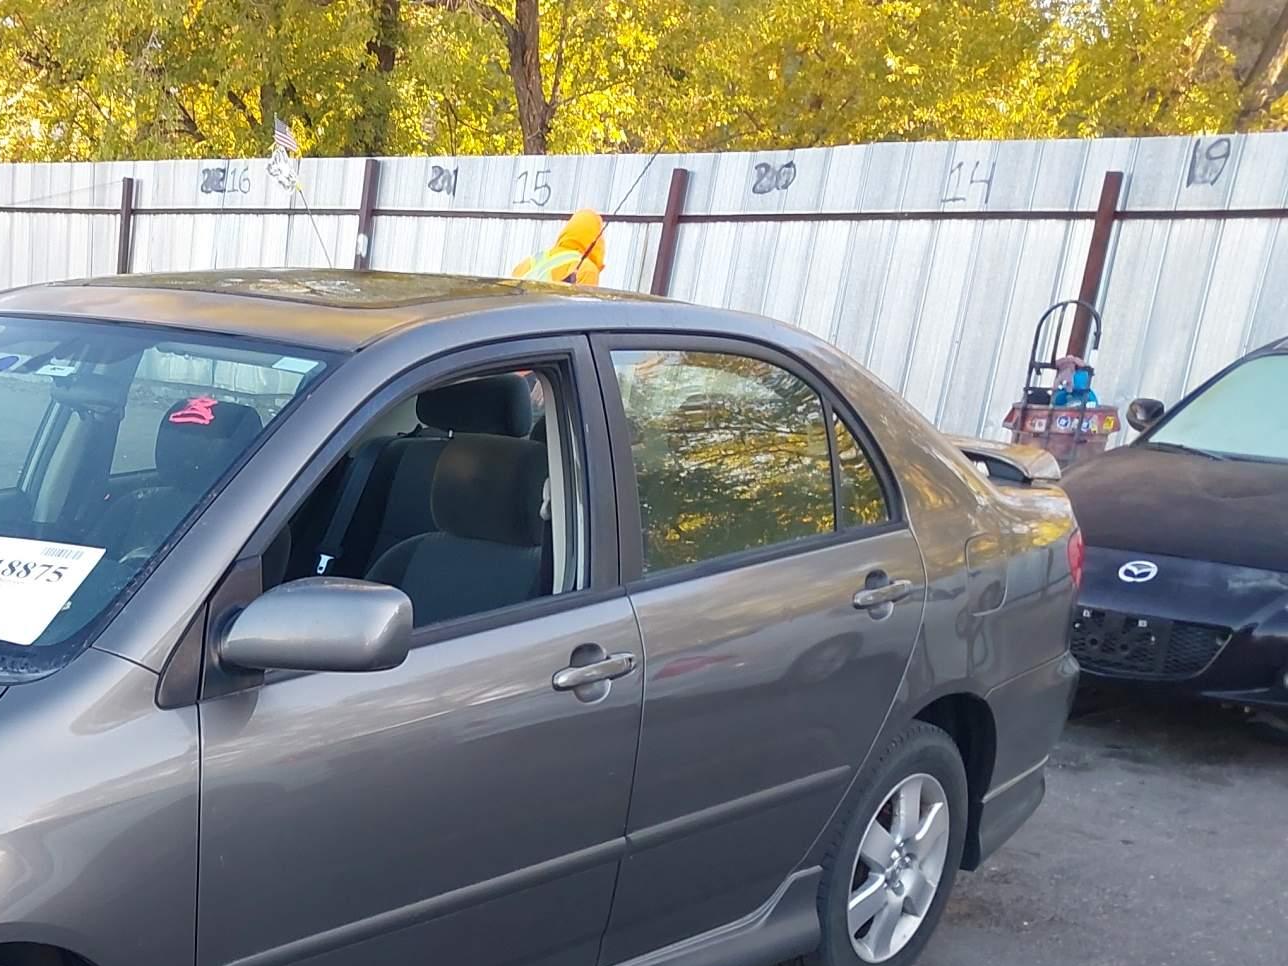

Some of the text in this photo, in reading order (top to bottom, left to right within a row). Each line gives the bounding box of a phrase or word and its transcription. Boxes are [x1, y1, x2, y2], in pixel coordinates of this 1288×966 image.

[227, 166, 251, 194] 16
[513, 169, 551, 206] 15
[941, 161, 996, 204] 14
